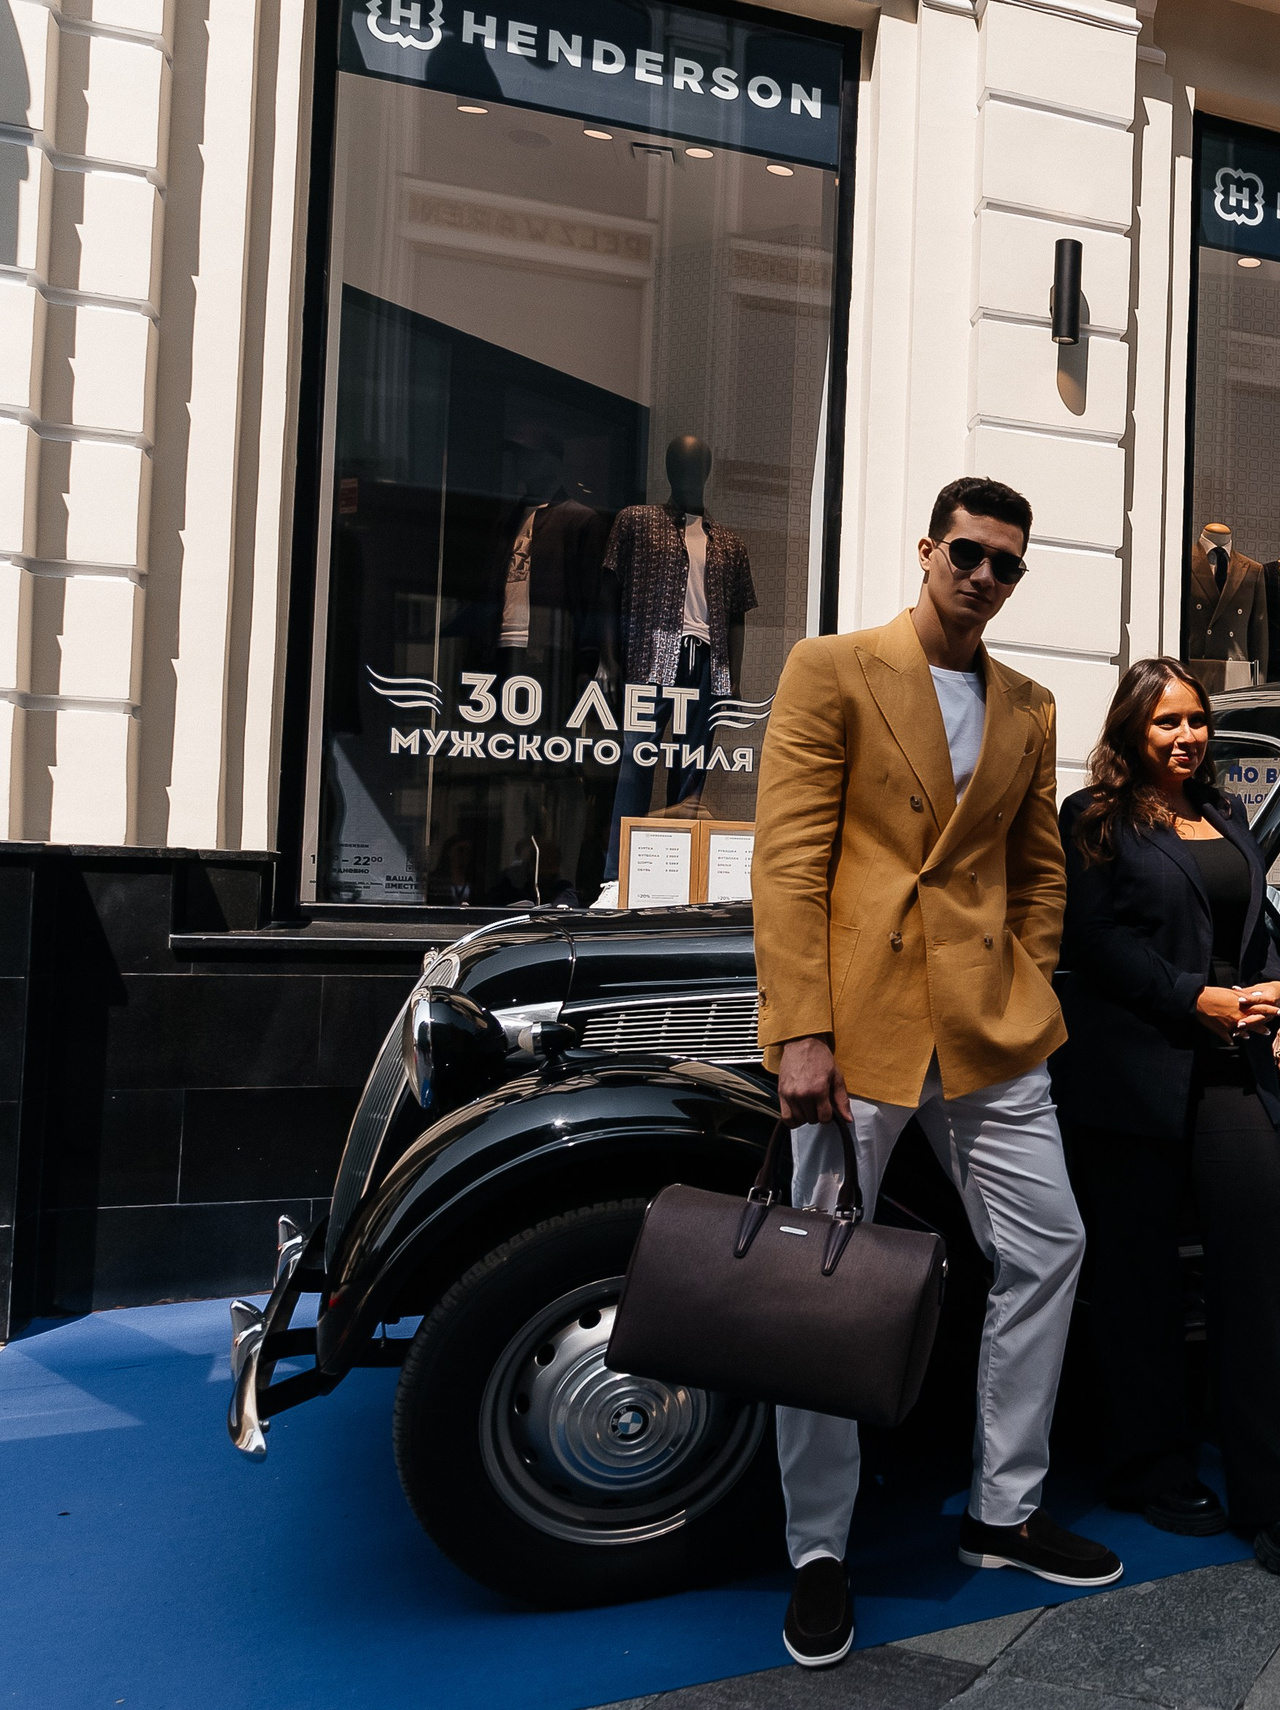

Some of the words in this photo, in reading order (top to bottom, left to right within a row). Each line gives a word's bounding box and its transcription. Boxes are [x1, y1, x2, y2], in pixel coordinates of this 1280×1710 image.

[461, 10, 822, 119] HENDERSON
[458, 672, 542, 726] 30
[566, 680, 700, 735] ЛЕТ
[389, 728, 622, 764] МУЖСКОГО
[633, 741, 755, 773] СТИЛЯ
